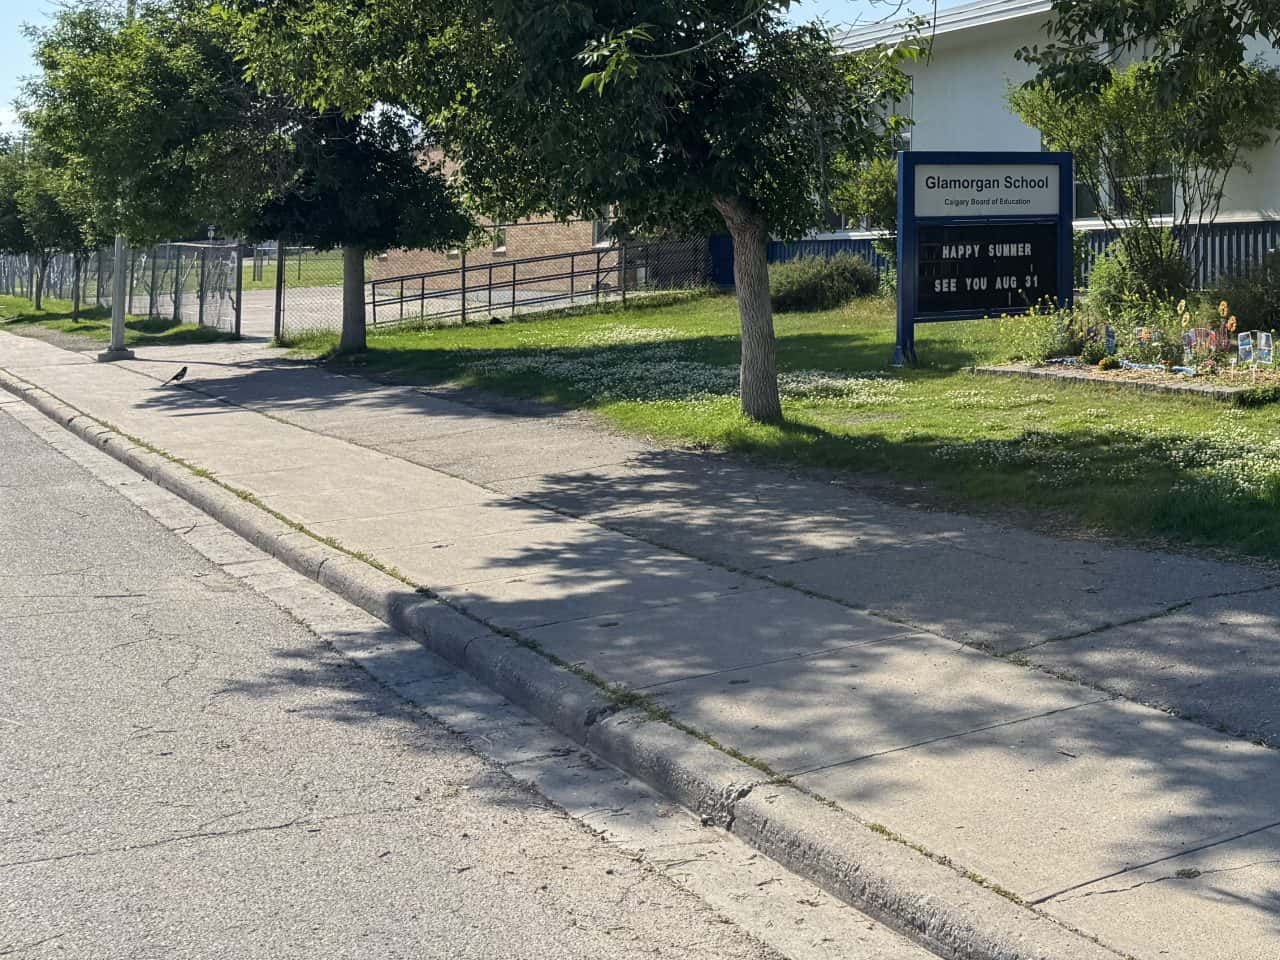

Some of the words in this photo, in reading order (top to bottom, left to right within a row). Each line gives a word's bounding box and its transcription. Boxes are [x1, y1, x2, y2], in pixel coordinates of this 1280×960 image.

[925, 175, 1000, 192] Glamorgan
[1003, 175, 1049, 189] School
[944, 198, 969, 207] Calgary
[999, 197, 1031, 205] Education
[942, 244, 980, 259] HAPPY
[988, 242, 1032, 257] SUMMER
[934, 278, 957, 292] SEE
[965, 276, 988, 290] YOU
[995, 275, 1017, 289] AUG
[1025, 275, 1038, 287] 31
